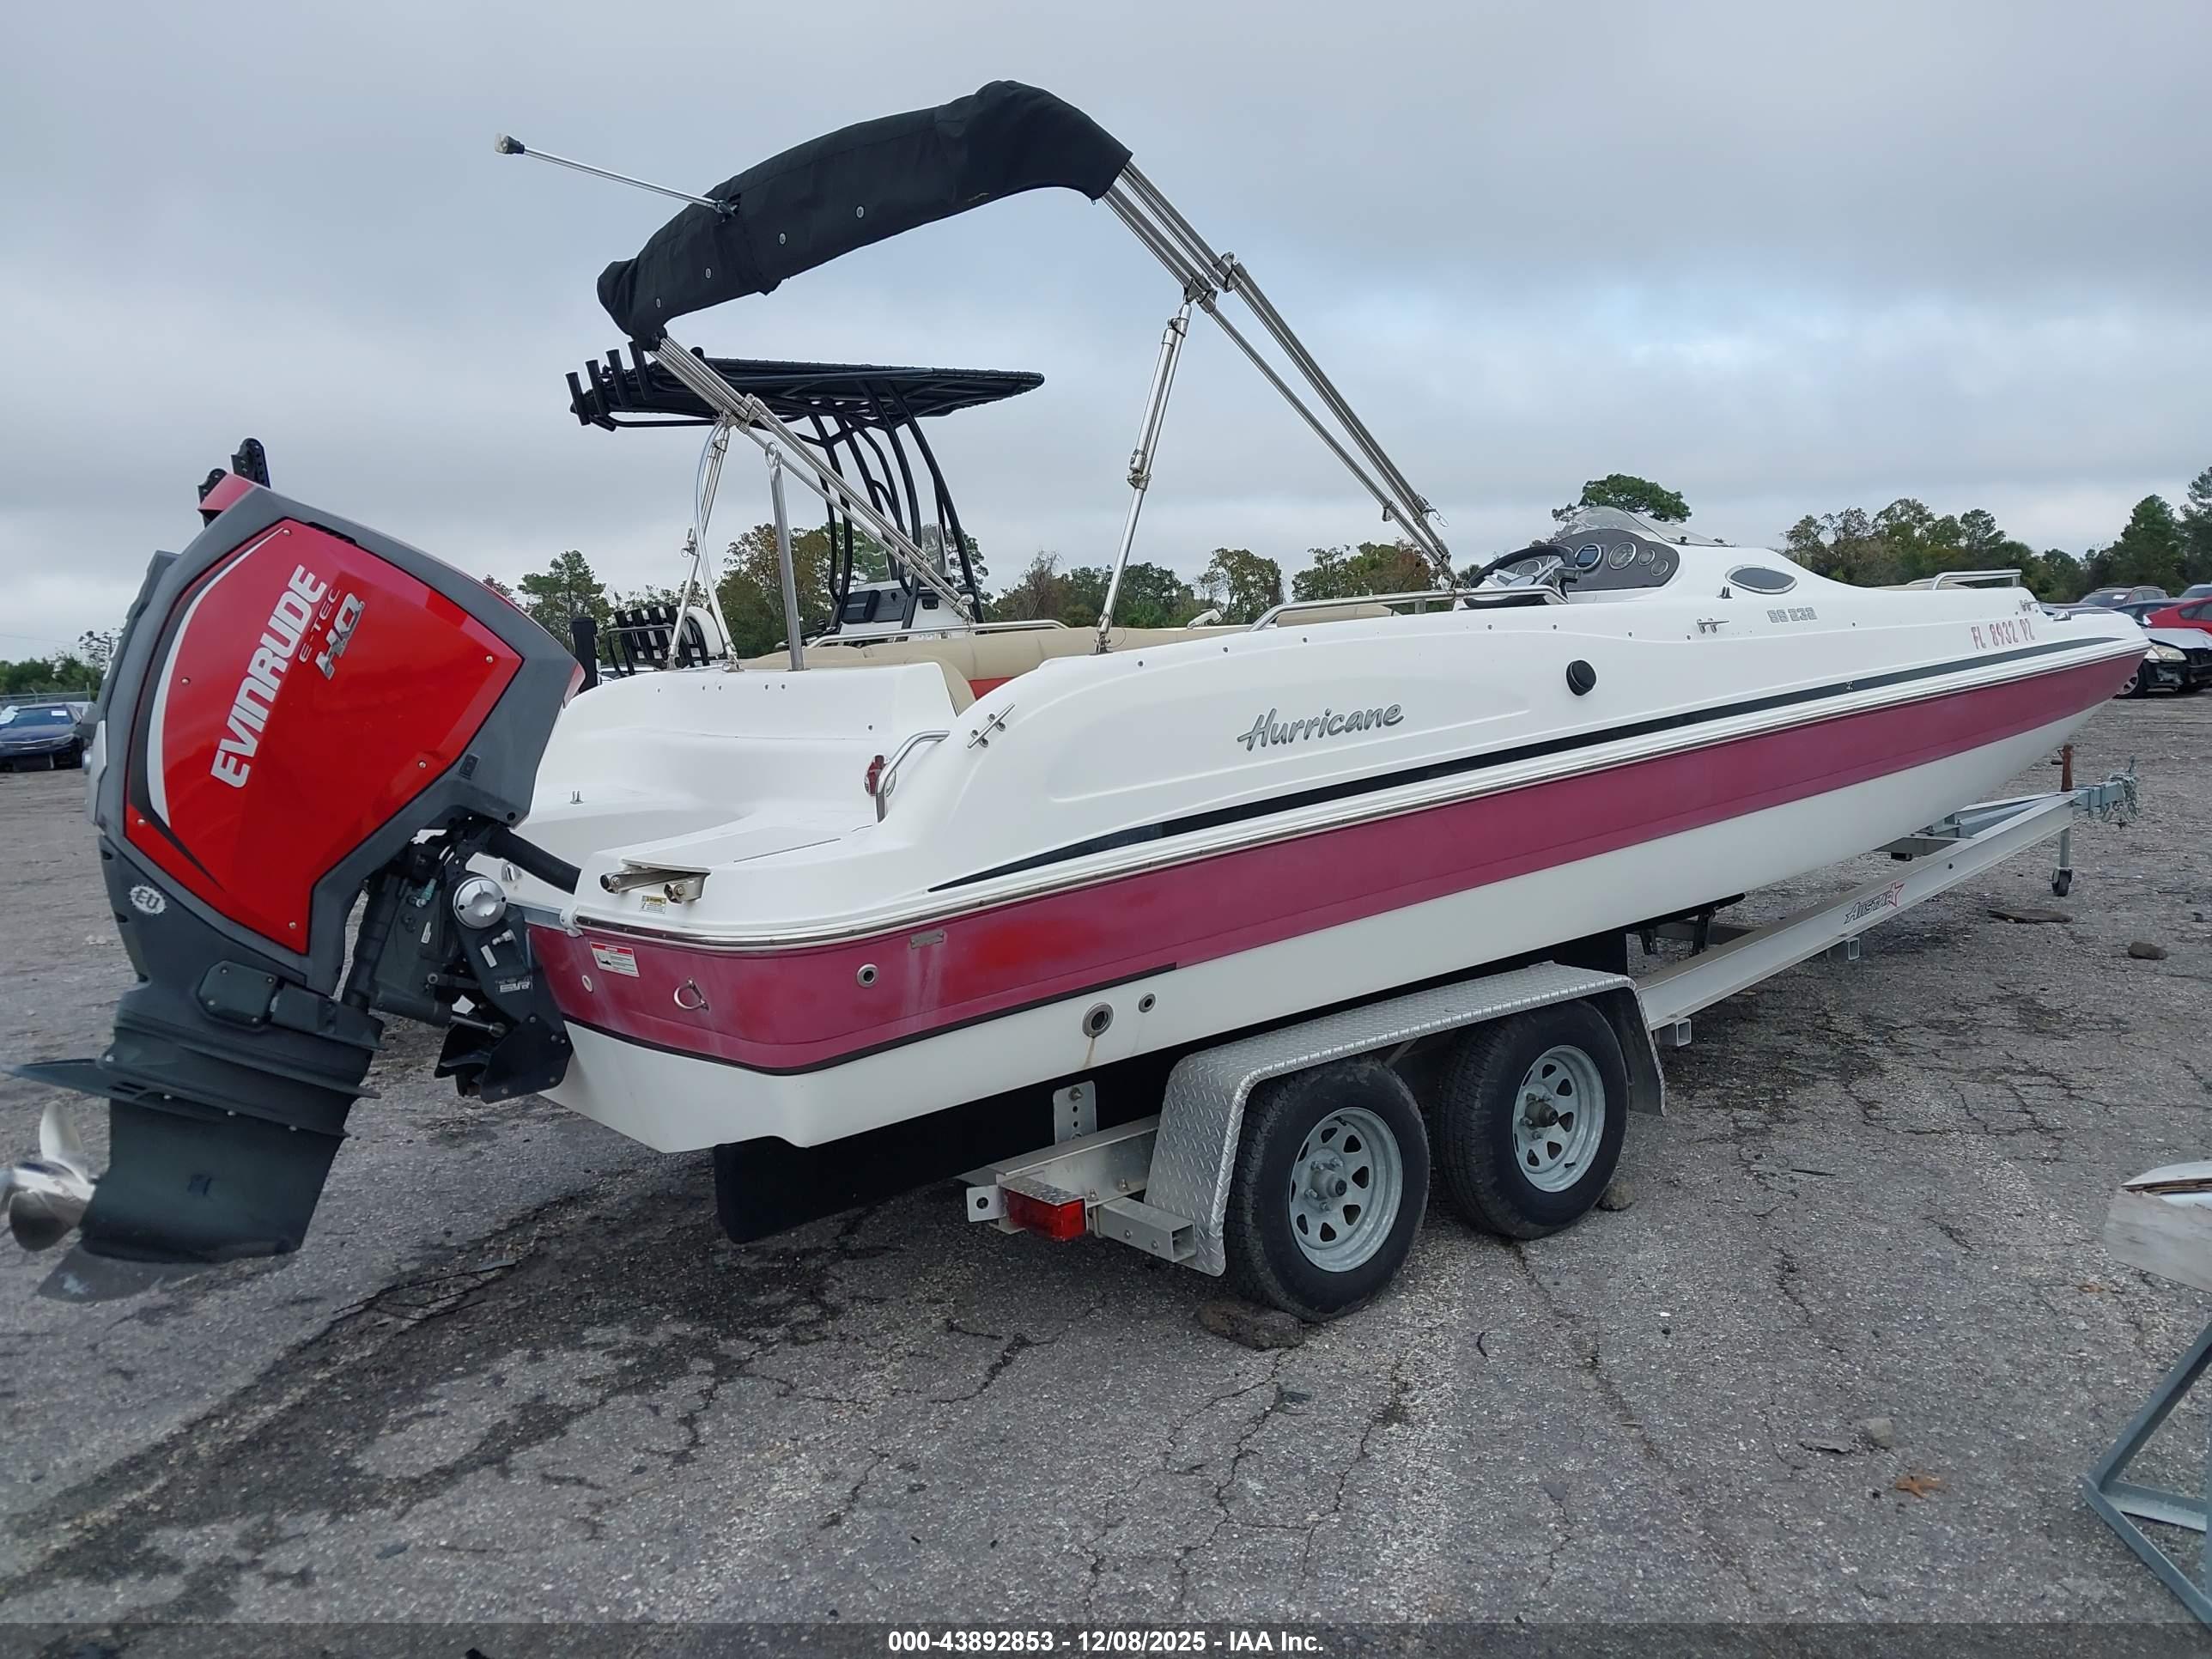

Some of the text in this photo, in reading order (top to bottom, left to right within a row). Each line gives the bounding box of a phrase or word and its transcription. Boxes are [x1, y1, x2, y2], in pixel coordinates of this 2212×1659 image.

[299, 588, 341, 663] E-TEC
[1787, 606, 1818, 622] 232
[1971, 625, 1986, 650] FL
[1989, 619, 2019, 647] 8932
[210, 564, 327, 788] EVINRUDE
[1237, 703, 1405, 751] Hurricane
